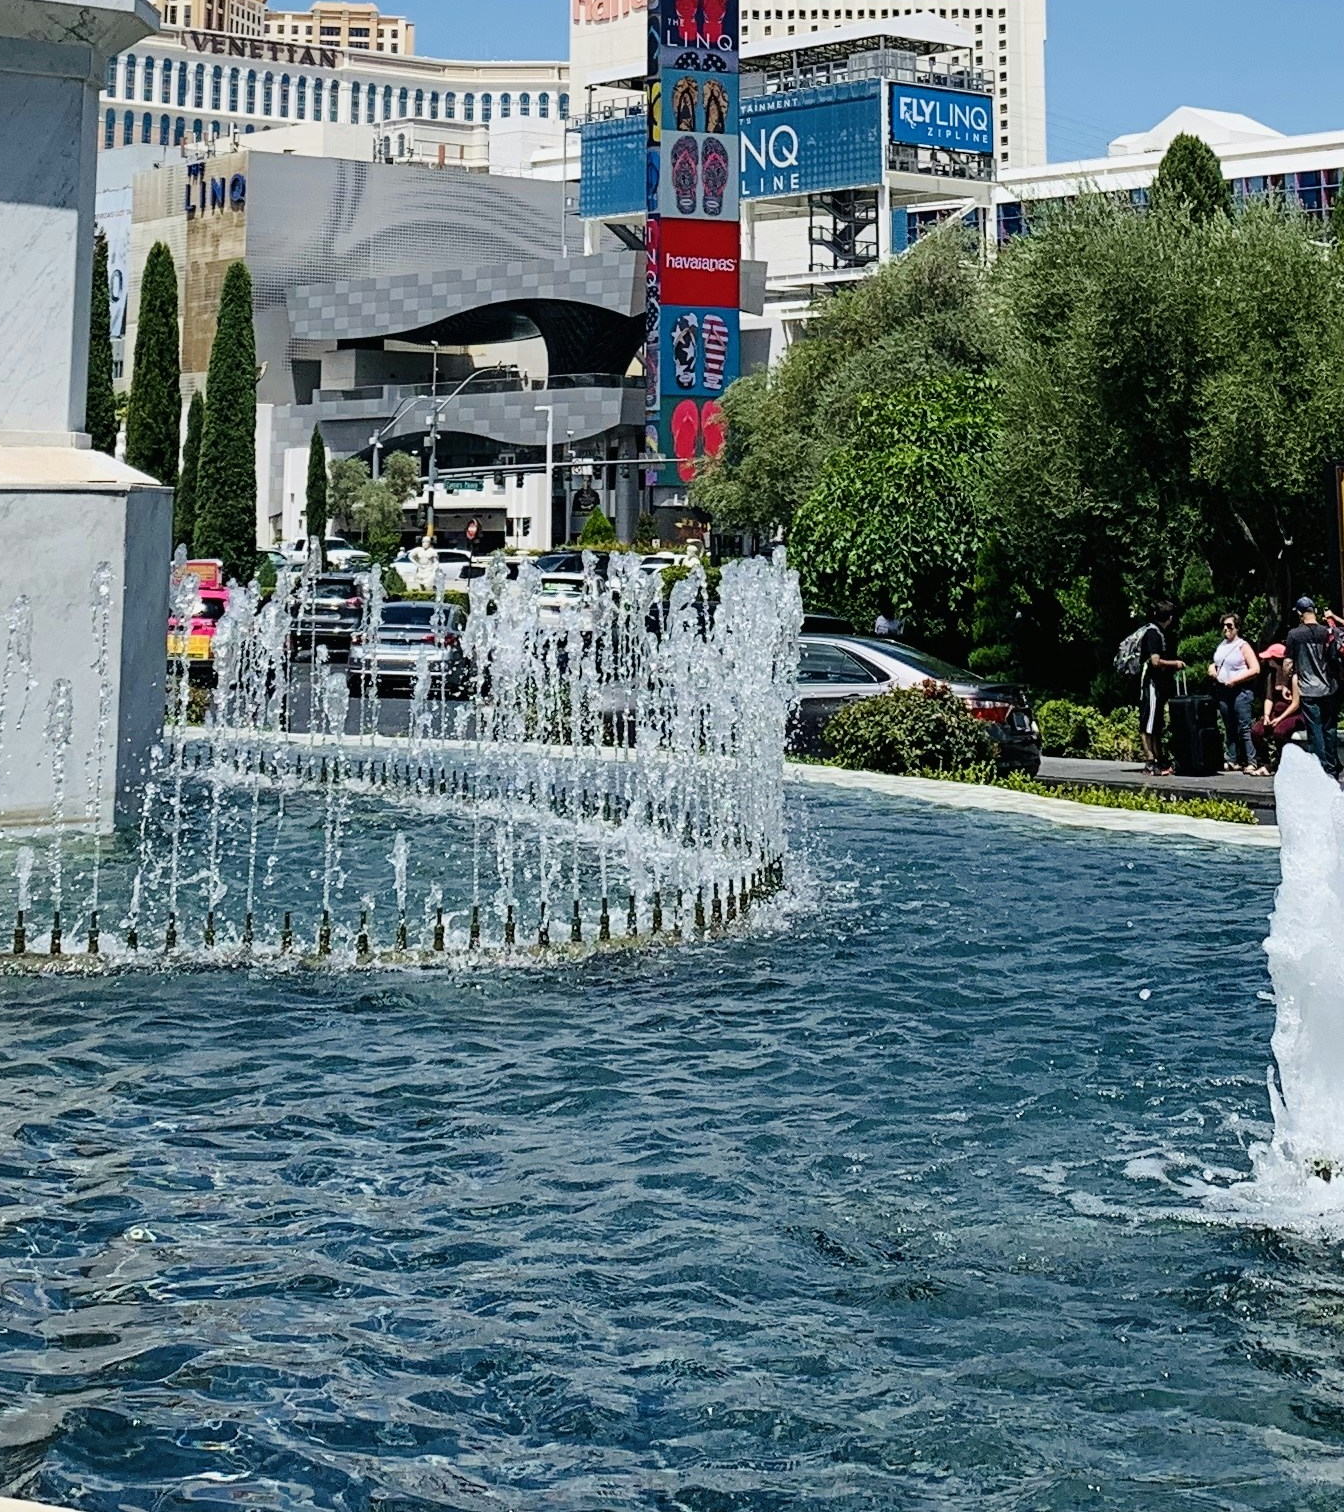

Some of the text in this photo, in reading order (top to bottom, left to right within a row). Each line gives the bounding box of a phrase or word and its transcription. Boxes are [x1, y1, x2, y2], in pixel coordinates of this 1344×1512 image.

[667, 17, 684, 27] THE
[191, 30, 339, 69] VENETIAN
[666, 29, 733, 52] LINQ
[740, 98, 799, 115] TAINMENT
[899, 96, 988, 132] FLYLINQ
[927, 127, 988, 144] ZIPLINE
[740, 124, 799, 173] NQ
[185, 173, 246, 211] LINQ
[741, 173, 800, 195] LINE
[666, 252, 735, 272] havaianas
